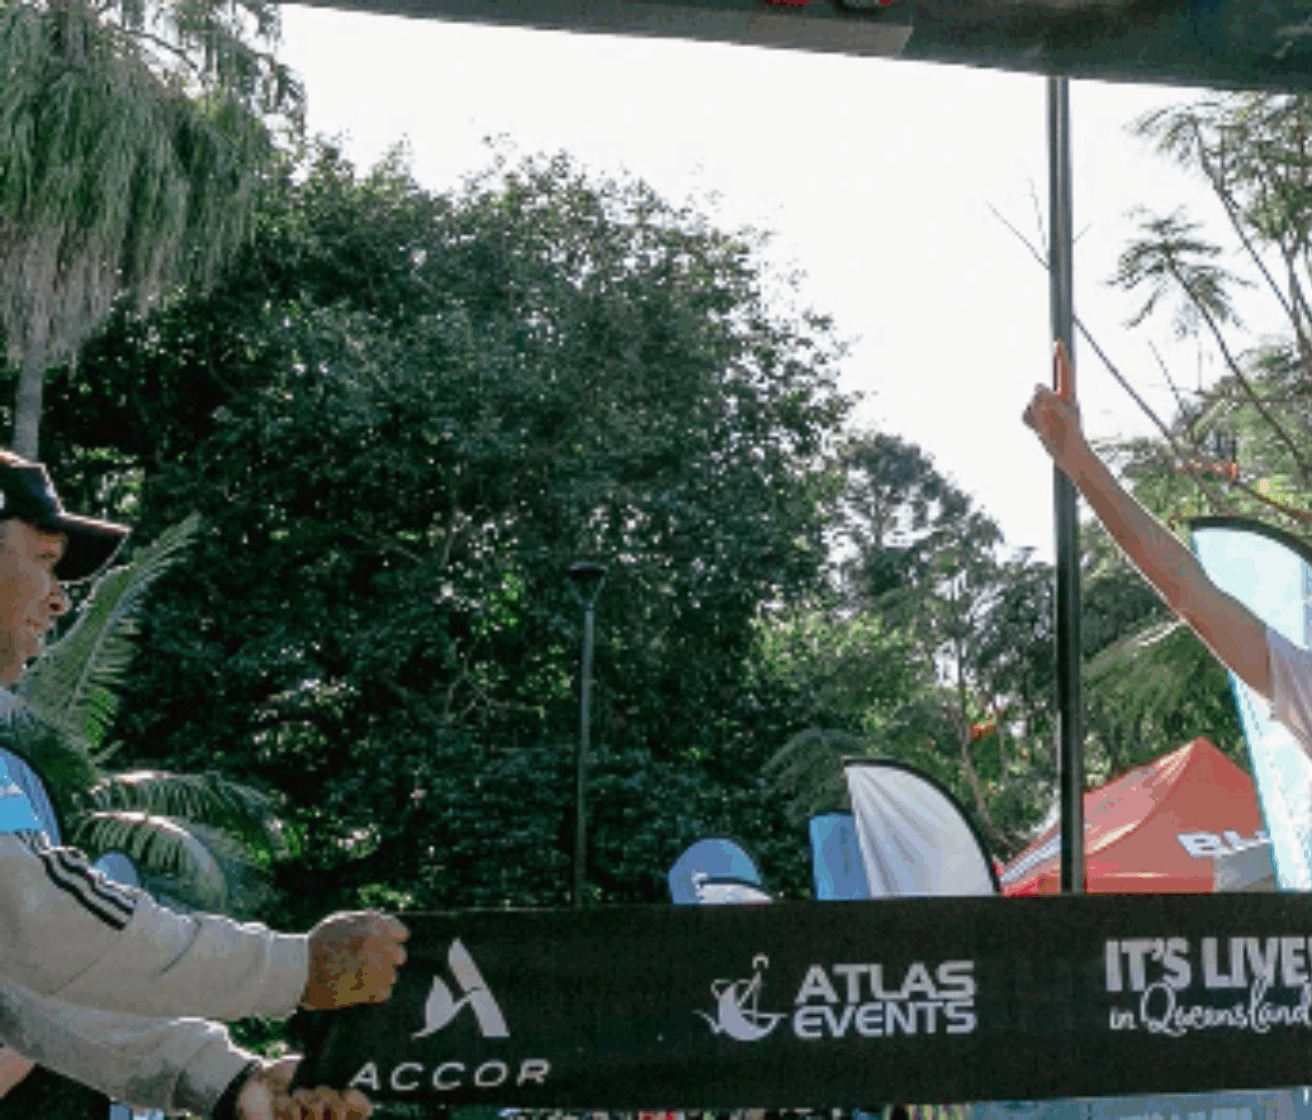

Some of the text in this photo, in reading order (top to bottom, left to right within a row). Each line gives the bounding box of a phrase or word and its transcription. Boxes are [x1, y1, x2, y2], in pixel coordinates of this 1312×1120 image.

[794, 960, 978, 1001] ATLAS
[1105, 936, 1192, 993] IT'S
[793, 1000, 978, 1039] EVENTS
[1108, 1008, 1138, 1031] in
[346, 1058, 552, 1092] ACCOR
